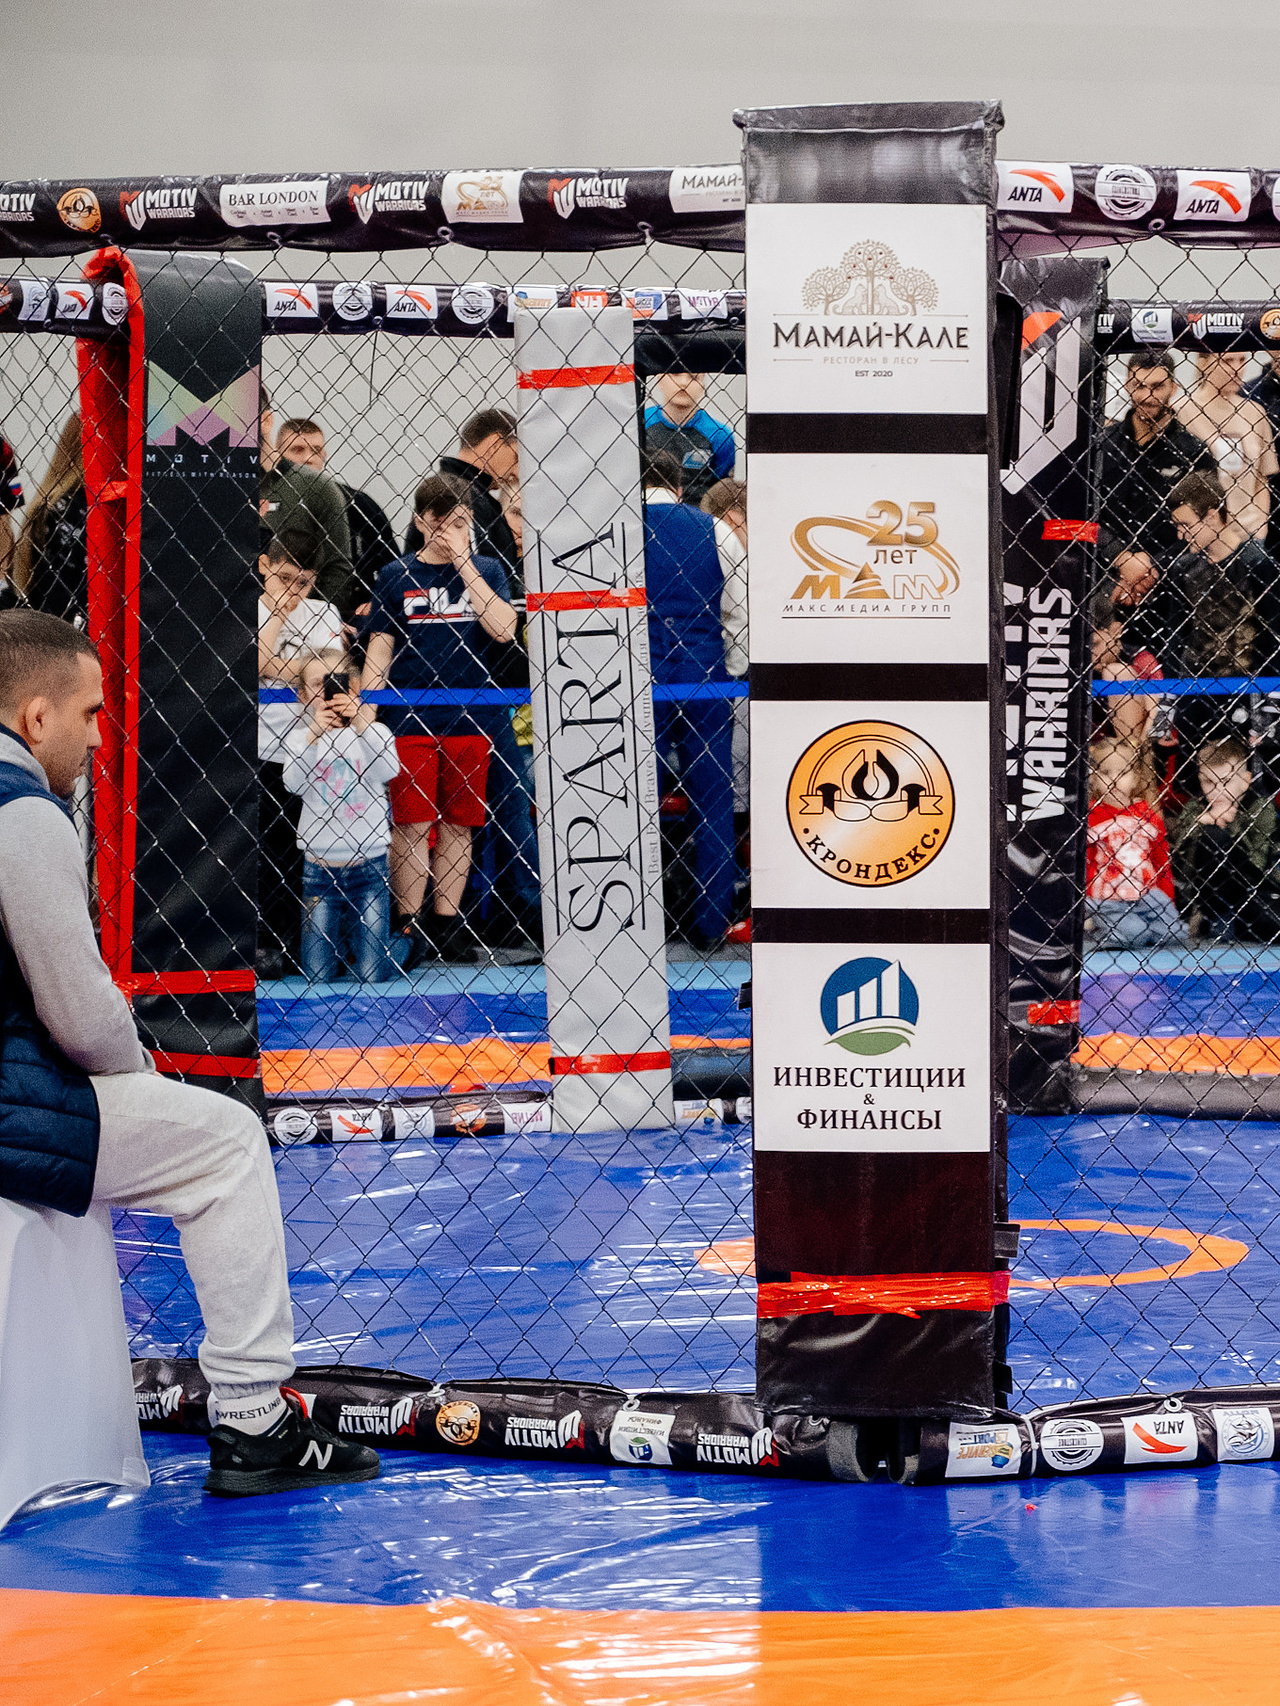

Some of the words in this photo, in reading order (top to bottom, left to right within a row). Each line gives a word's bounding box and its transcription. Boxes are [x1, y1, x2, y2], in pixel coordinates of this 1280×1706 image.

[576, 177, 629, 197] MOTIV
[681, 173, 745, 189] МАМАЙ-
[145, 188, 198, 209] MOTIV
[228, 194, 256, 206] BAR
[259, 190, 319, 205] LONDON
[375, 181, 430, 200] MOTIV
[1007, 186, 1043, 203] ANTA
[0, 193, 36, 212] OTIV
[374, 199, 427, 212] WARRIORS
[576, 195, 627, 210] WARRIORS
[1185, 199, 1220, 215] ANTA
[147, 207, 196, 219] WARRIORS
[274, 301, 298, 311] ANTA
[393, 301, 417, 312] ANTA
[1207, 313, 1245, 326] MOTIV
[823, 356, 877, 365] РЕСТОРАН
[882, 357, 888, 365] В
[892, 357, 919, 366] ЛЕСУ
[866, 499, 938, 548] 25
[873, 549, 917, 565] лет
[782, 604, 827, 613] МАКС
[833, 604, 891, 613] МЕДИА
[901, 604, 951, 613] ГРУПП
[1021, 586, 1072, 821] WARRIORS
[551, 522, 635, 933] SPARTA
[643, 759, 656, 804] Brave
[646, 841, 659, 875] Best
[806, 833, 936, 882] КРОНДЕКС
[773, 1066, 966, 1093] ИНВЕСТИЦИИ
[863, 1093, 875, 1105] &
[797, 1108, 942, 1130] ФИНАНСЫ
[340, 1404, 389, 1417] WARRIORS
[338, 1415, 389, 1436] MOTIV
[506, 1416, 557, 1430] WARRIORS
[1153, 1420, 1184, 1435] ANTA
[504, 1427, 558, 1449] MOTIV
[697, 1433, 749, 1447] WARRIORS
[298, 1440, 333, 1470] N
[696, 1444, 752, 1465] MOTIV
